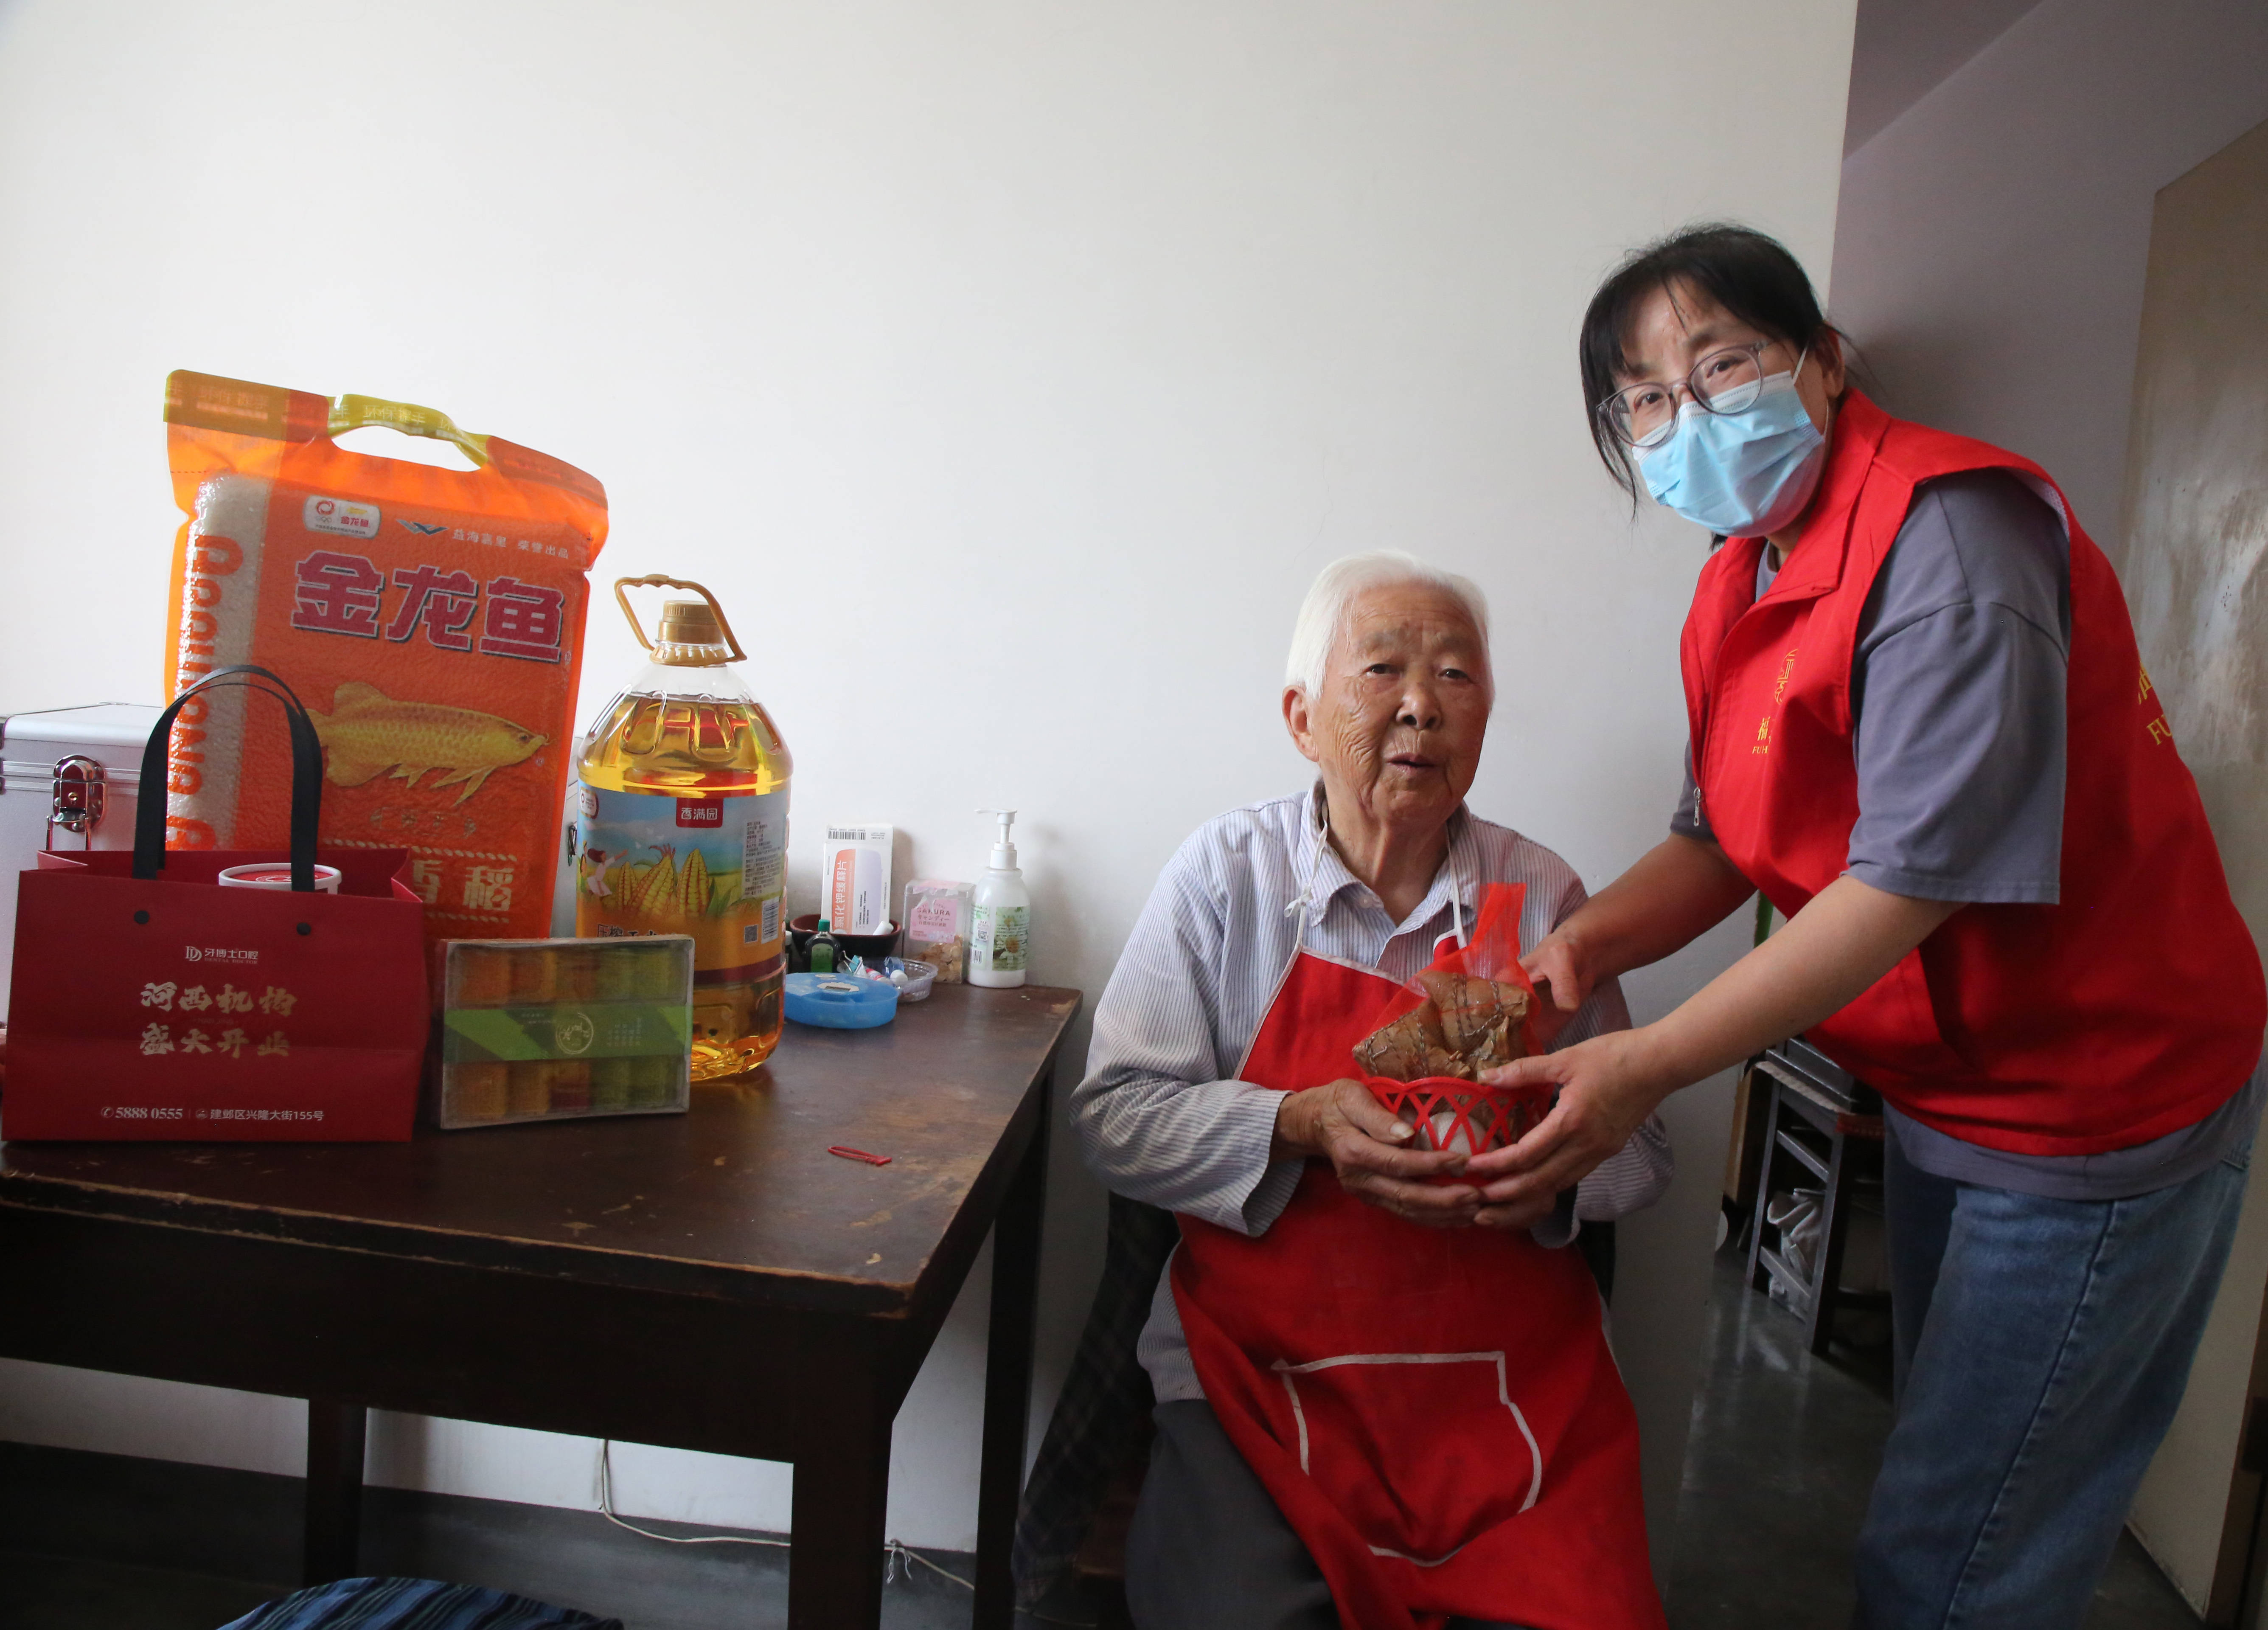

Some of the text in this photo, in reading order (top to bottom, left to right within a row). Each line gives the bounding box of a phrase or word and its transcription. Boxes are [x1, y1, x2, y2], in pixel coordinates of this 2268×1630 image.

[340, 516, 369, 528] 金龙鱼
[452, 529, 569, 559] 益海嘉里 荣誉出品
[289, 550, 567, 664] 金龙鱼
[680, 807, 718, 821] 香满园
[205, 948, 258, 960] 牙博士口腔
[140, 981, 298, 1017] 河西机构
[139, 1022, 290, 1058] 盛大开业
[115, 1107, 324, 1121] 5888 0555 建邺区兴隆大街155号
